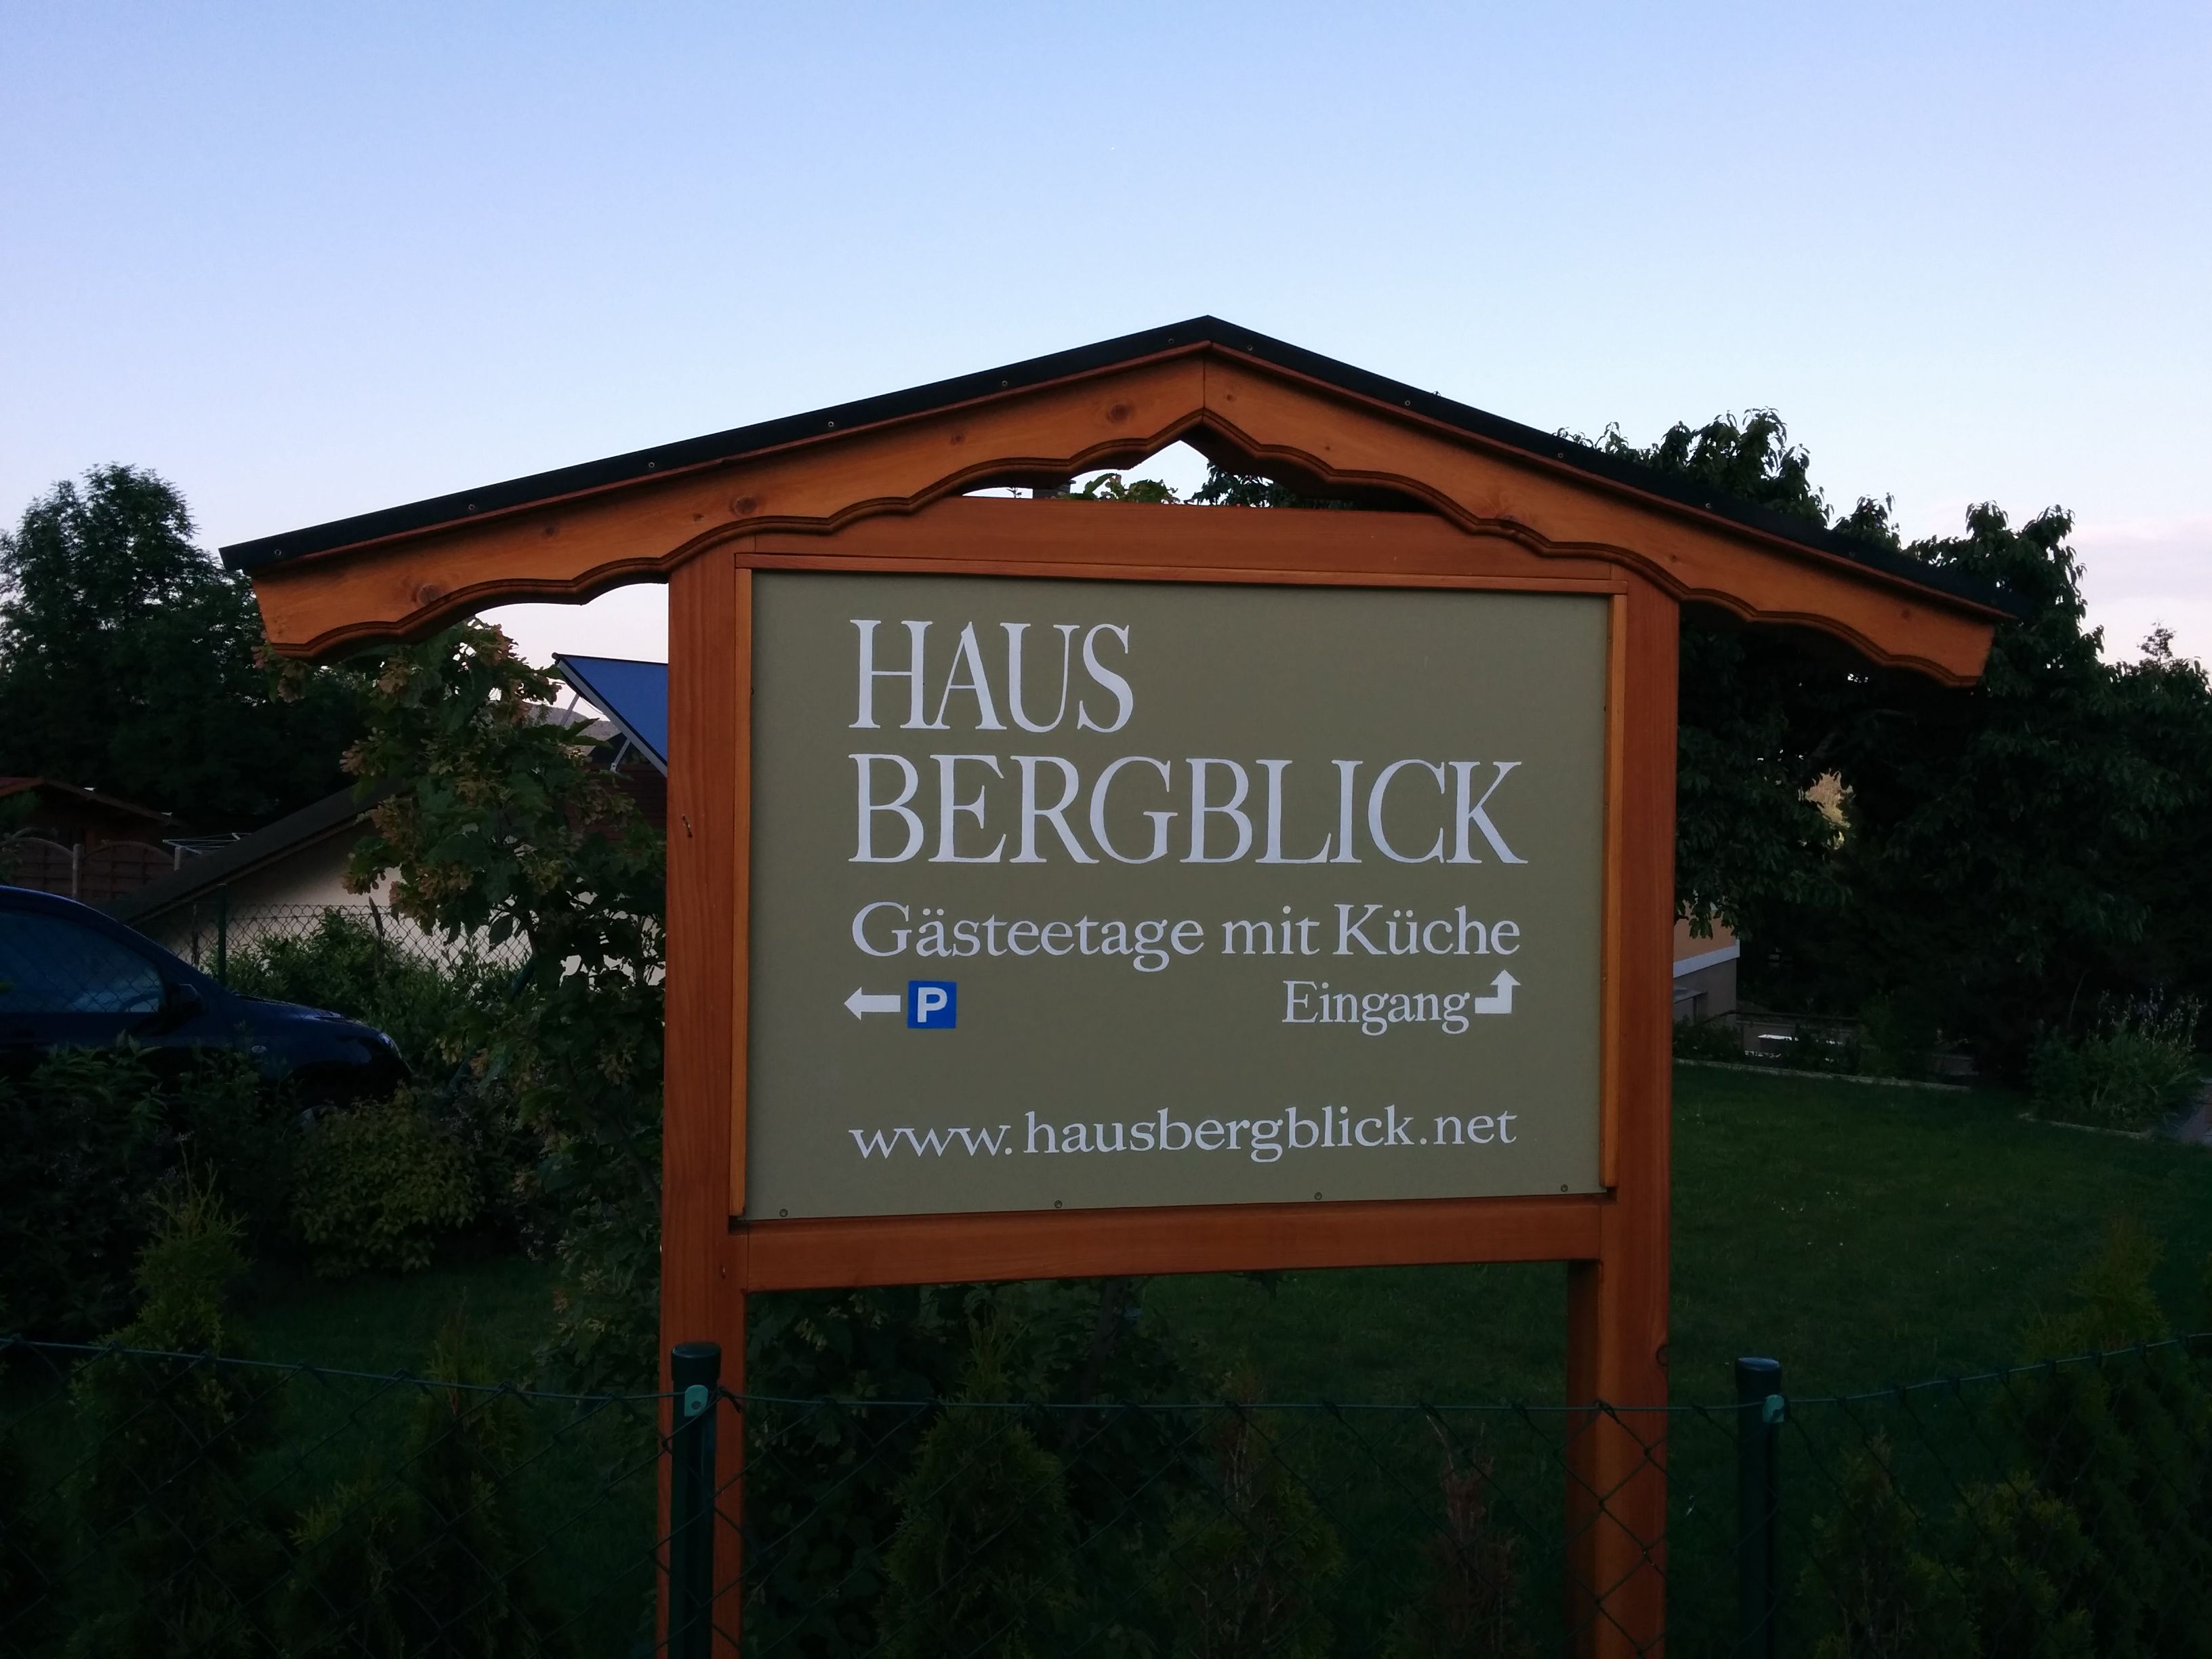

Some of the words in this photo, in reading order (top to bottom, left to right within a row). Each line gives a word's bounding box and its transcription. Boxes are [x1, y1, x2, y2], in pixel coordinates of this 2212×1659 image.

[849, 620, 1134, 733] HAUS
[848, 754, 1528, 865] BERGBLICK
[852, 902, 1204, 972] Gästeetage
[1221, 905, 1320, 955] mit
[1333, 903, 1521, 956] Küche
[918, 987, 947, 1023] P
[1282, 981, 1472, 1036] Eingang
[849, 1105, 1517, 1163] www.hausbergblick.net
